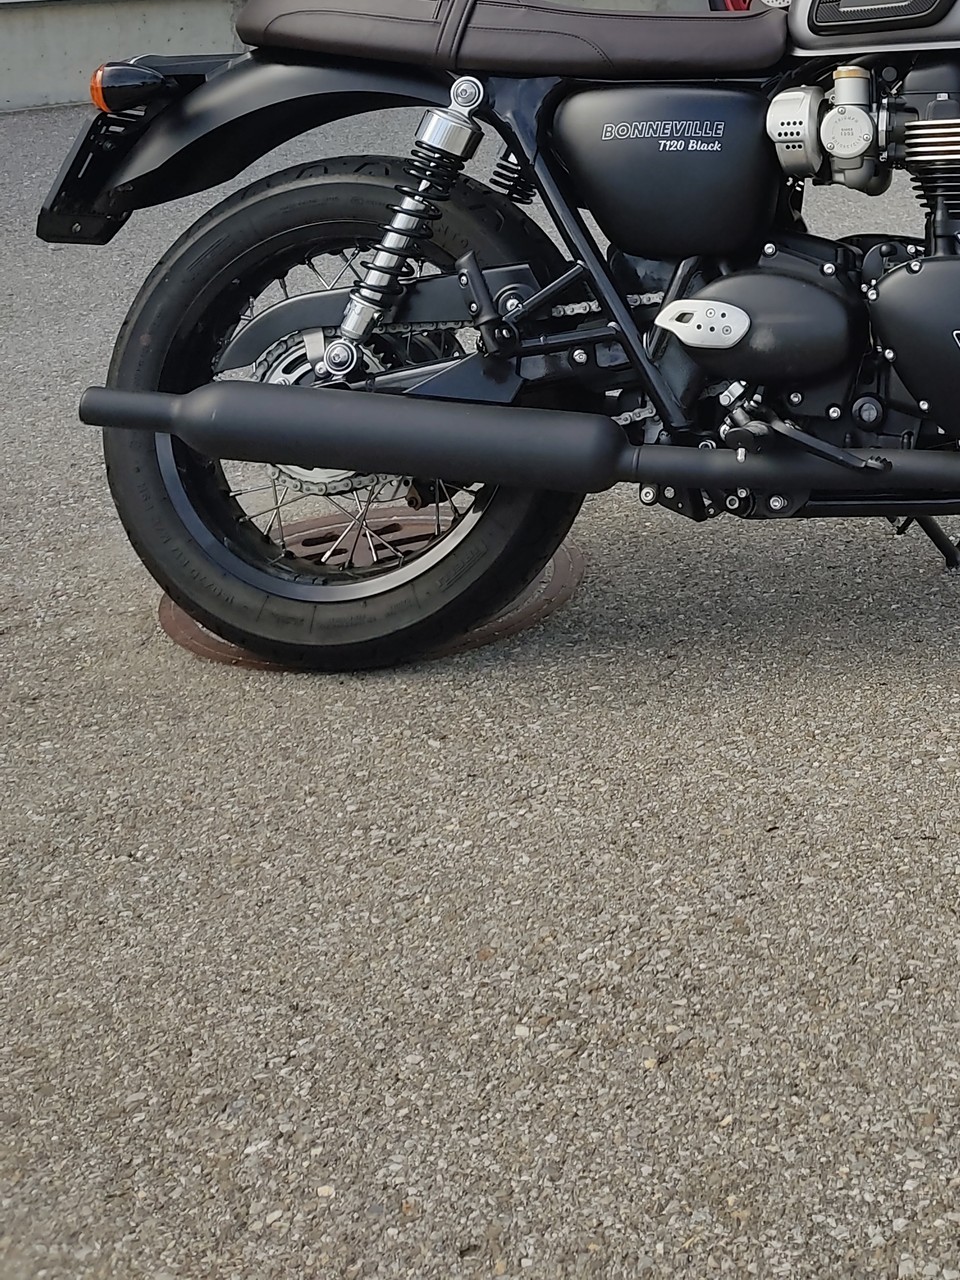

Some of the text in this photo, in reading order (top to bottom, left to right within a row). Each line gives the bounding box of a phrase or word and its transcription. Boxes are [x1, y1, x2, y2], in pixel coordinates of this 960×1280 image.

[601, 121, 725, 140] BONNEVILLE
[658, 140, 722, 151] T120 Black
